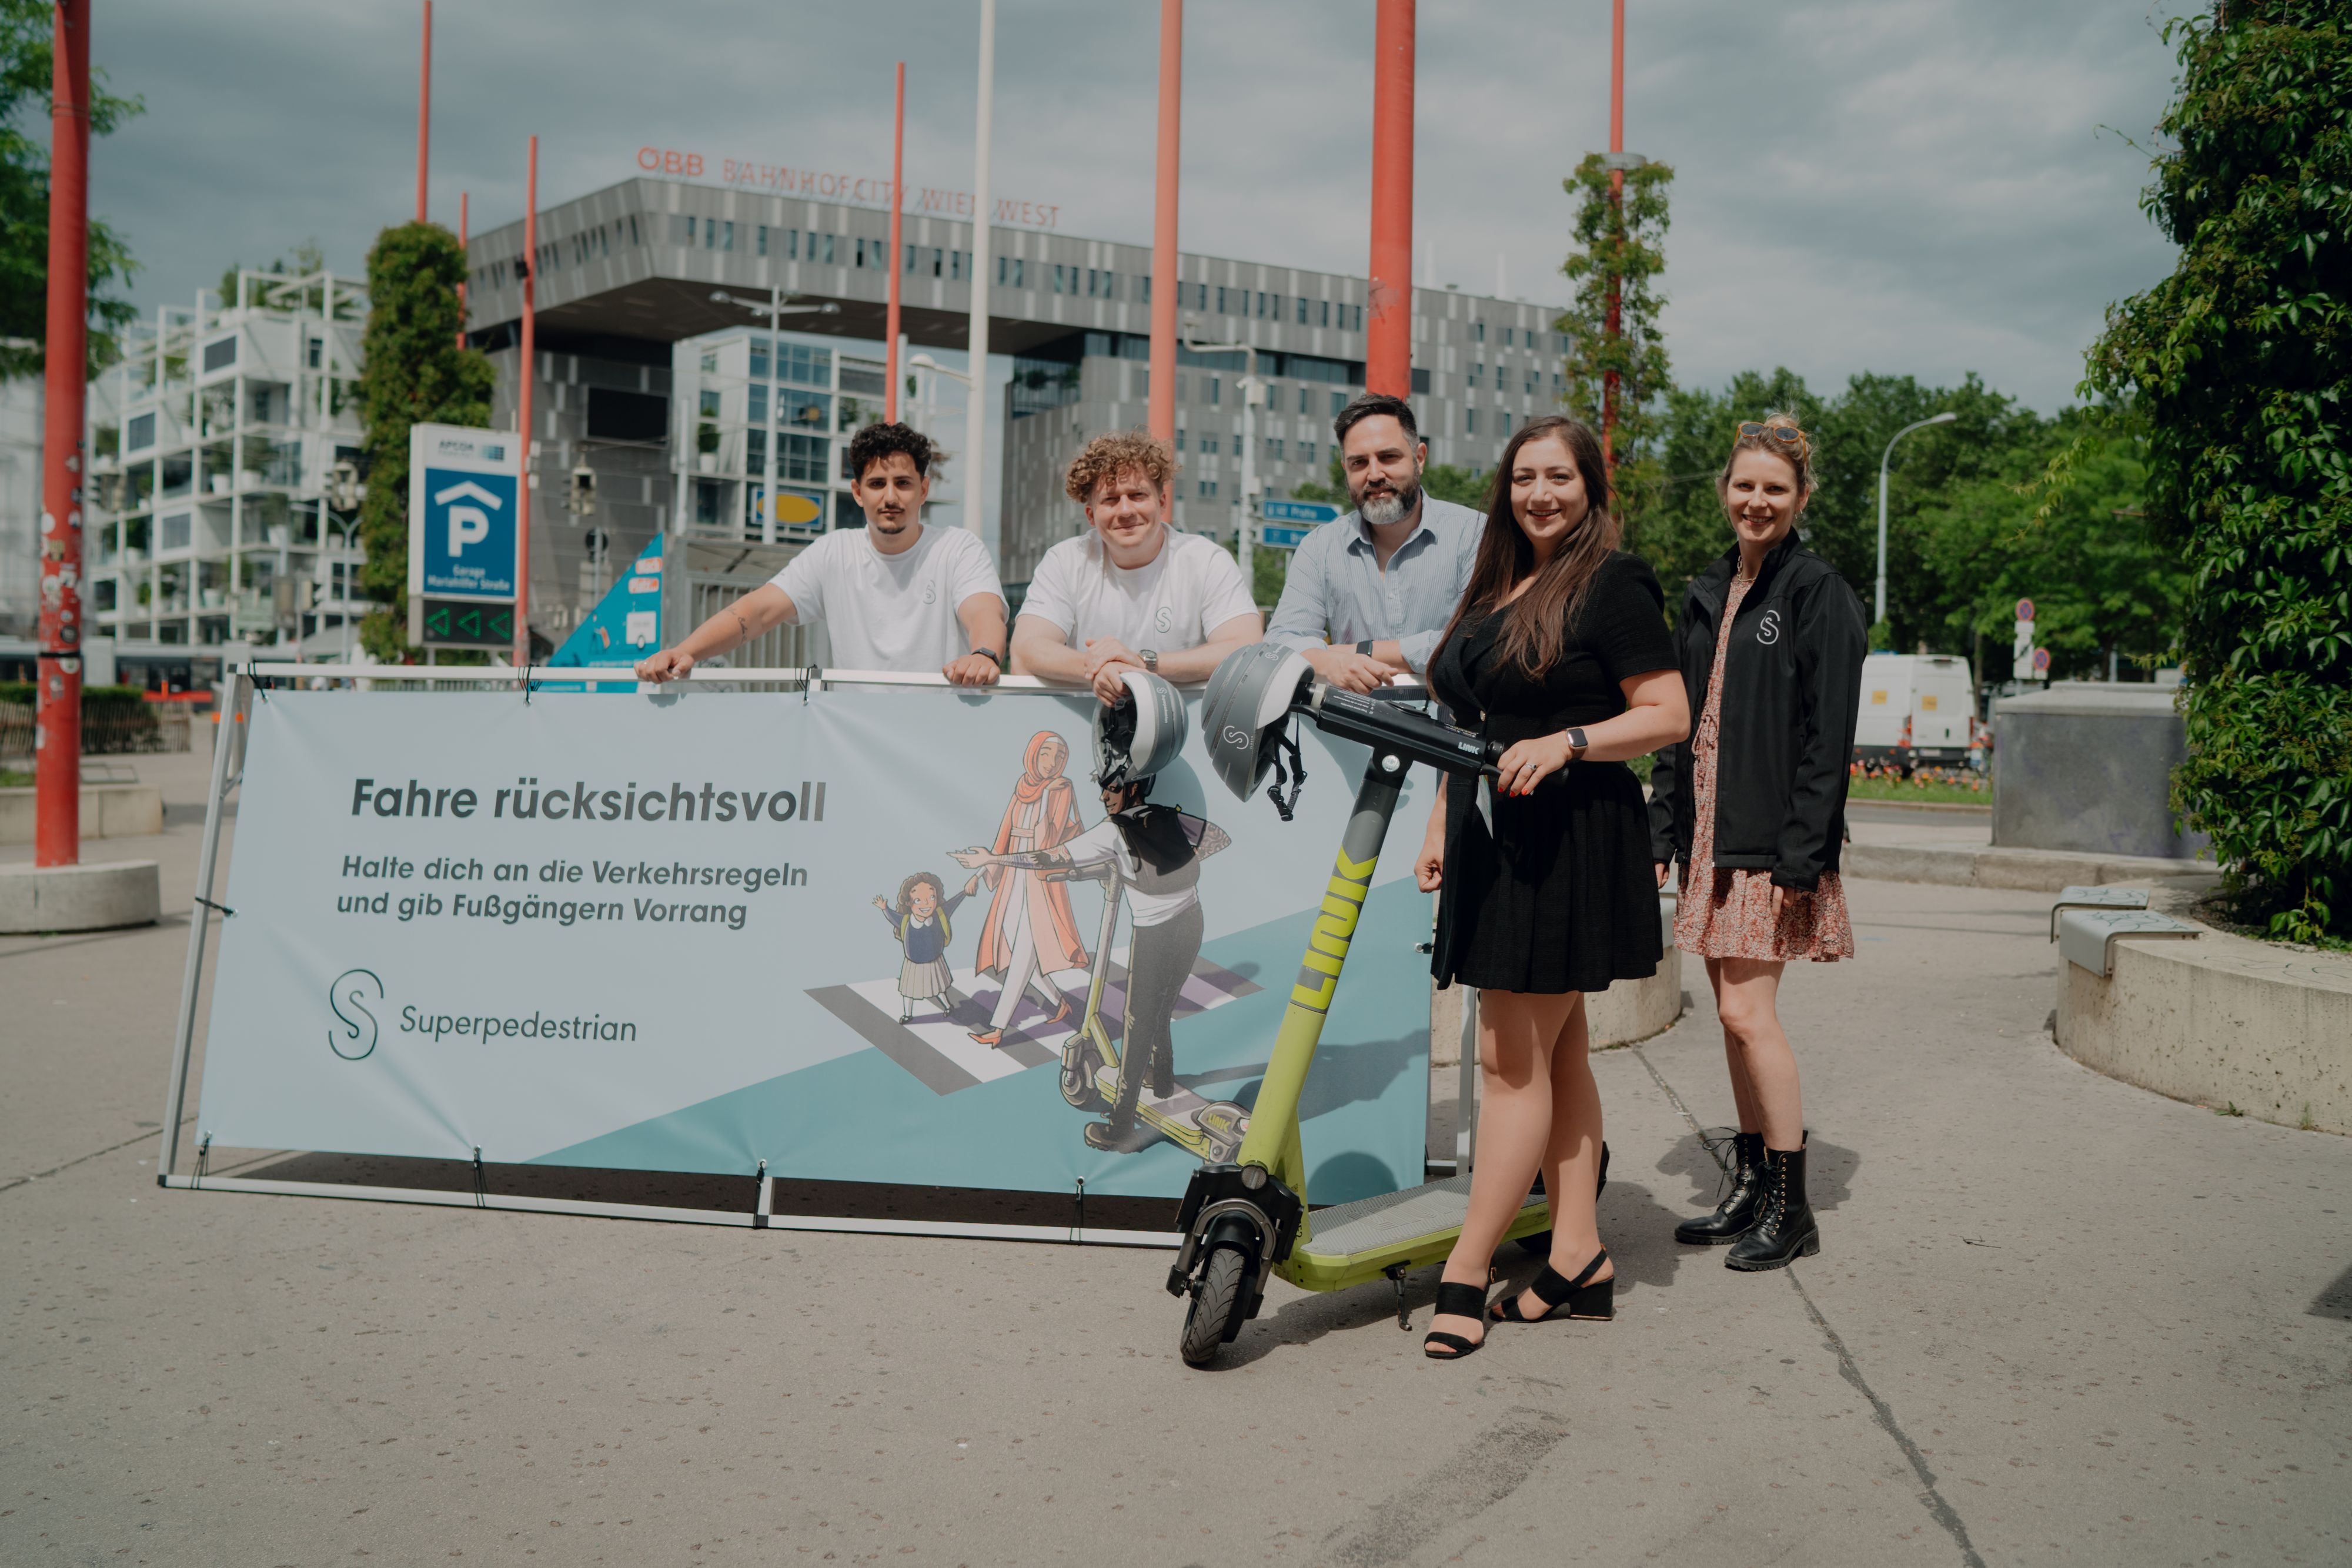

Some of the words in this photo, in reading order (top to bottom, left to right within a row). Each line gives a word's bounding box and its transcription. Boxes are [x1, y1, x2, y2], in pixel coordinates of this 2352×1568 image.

[637, 146, 704, 177] ÖBB
[997, 199, 1060, 228] WEST
[448, 504, 489, 558] P
[1458, 741, 1480, 755] LINK
[351, 778, 478, 818] Fahre
[493, 777, 826, 823] rücksichtsvoll
[342, 855, 415, 879] Halte
[423, 857, 483, 881] dich
[493, 864, 529, 882] an
[539, 860, 583, 883] die
[592, 860, 807, 893] Verkehrsregeln
[337, 892, 390, 914] und
[397, 893, 443, 922] gib
[452, 894, 624, 927] Fußgängern
[633, 898, 747, 931] Vorrang
[1290, 842, 1378, 1010] LINK
[400, 1005, 637, 1045] Superpedestrian
[1207, 1112, 1231, 1134] LINK
